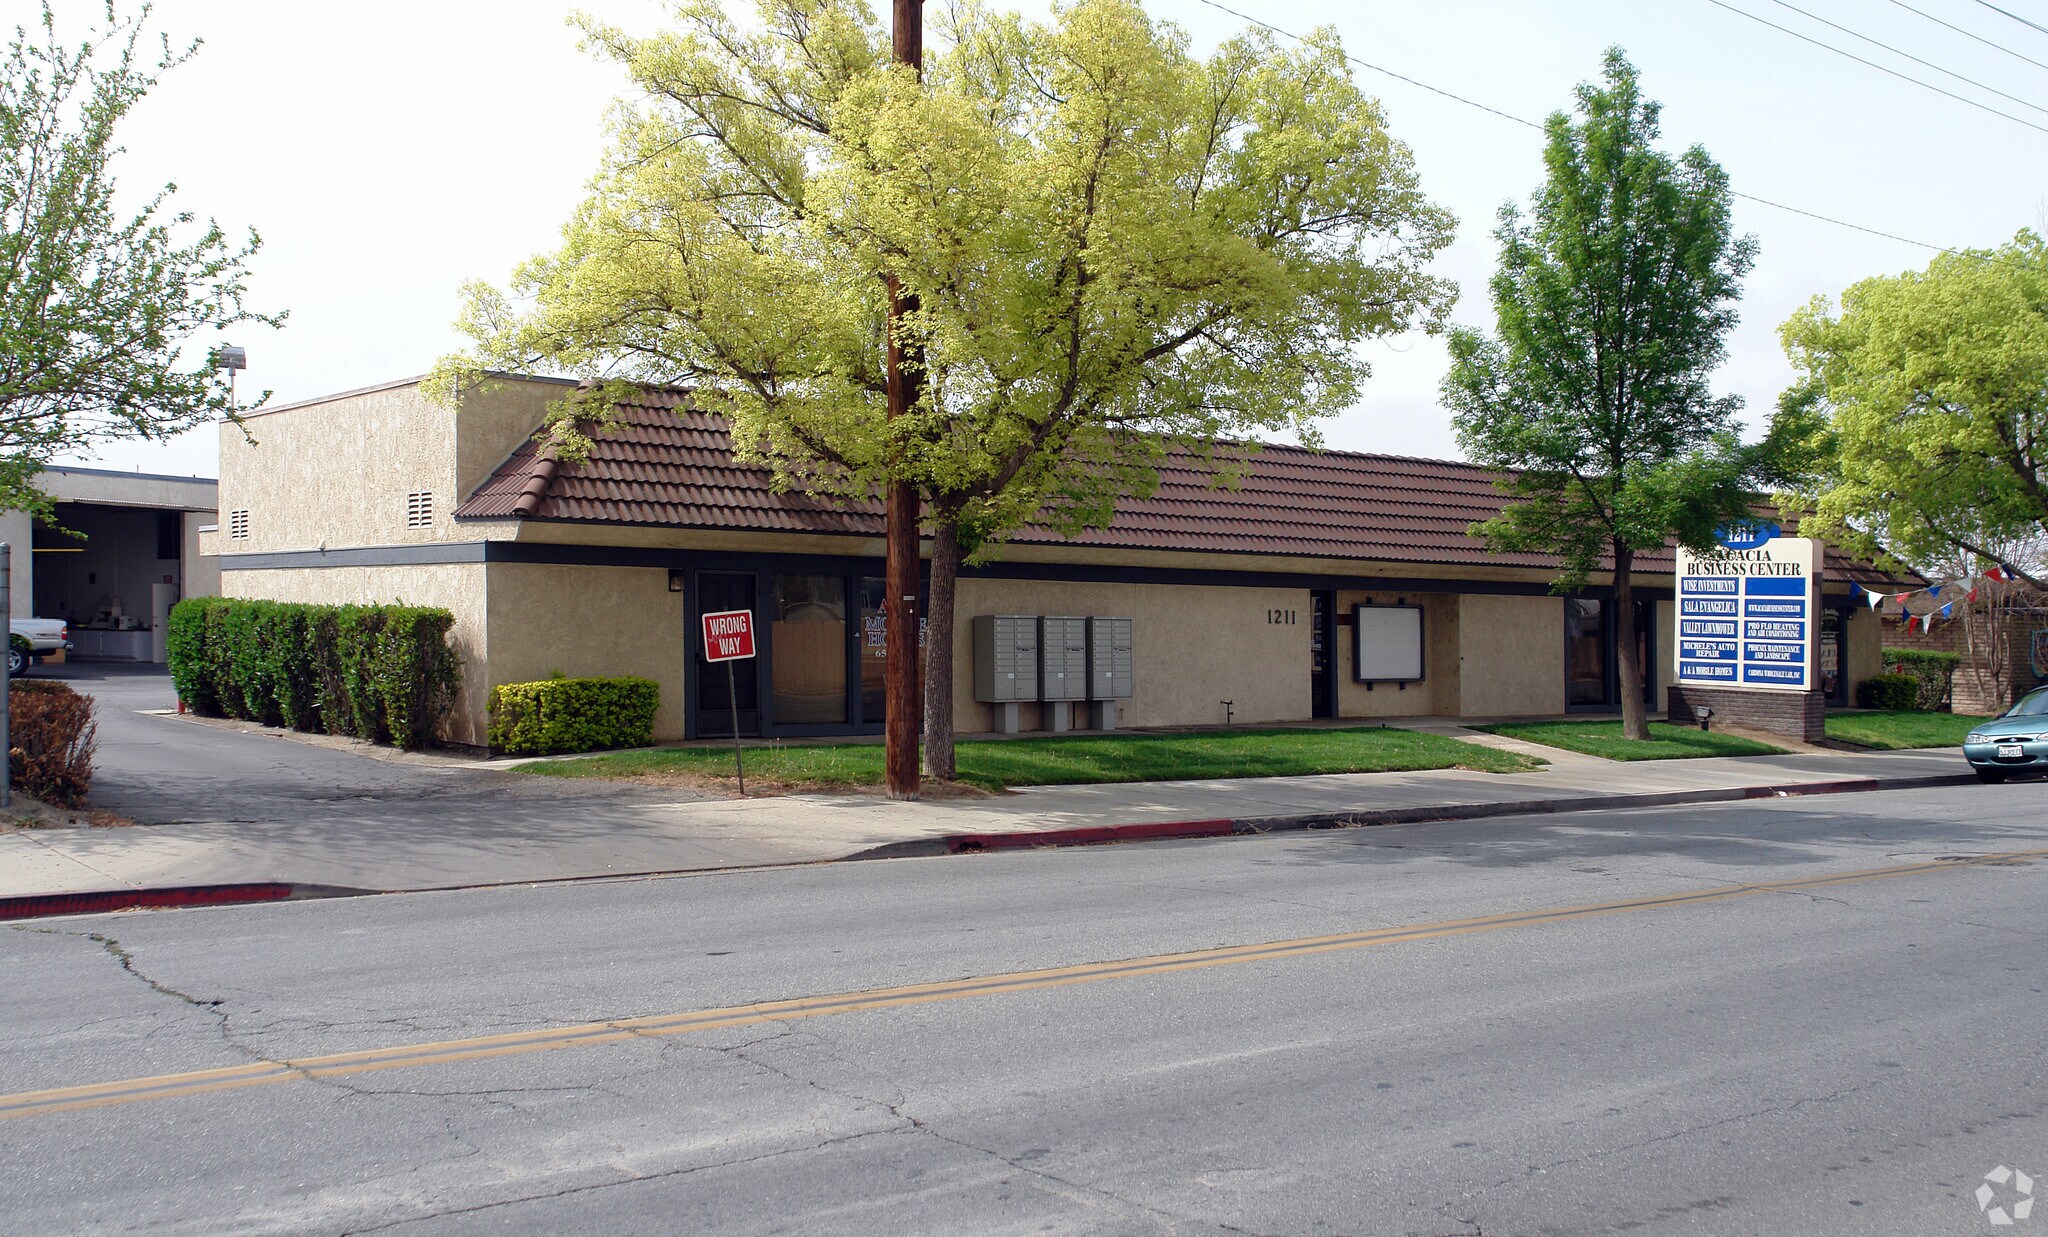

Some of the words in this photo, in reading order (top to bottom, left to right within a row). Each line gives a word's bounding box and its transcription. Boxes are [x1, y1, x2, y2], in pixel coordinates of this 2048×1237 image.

[1687, 563, 1746, 575] BUSINESS
[1750, 563, 1801, 575] CENTER
[1683, 580, 1697, 591] WISE
[1698, 580, 1735, 592] INVESTMENTS
[1684, 601, 1699, 612] SALA
[1700, 601, 1735, 613] EVANGELICA
[1268, 610, 1295, 624] 1211
[709, 616, 747, 635] WRONG
[1683, 622, 1700, 633] VALLEY
[1702, 623, 1734, 634] LAWNMOWER
[719, 637, 740, 655] WAY
[1683, 642, 1717, 650] MICHELE'S
[1768, 645, 1800, 653] MAINTENANCE
[1696, 667, 1714, 675] MOBILE
[1715, 667, 1732, 675] HOMES
